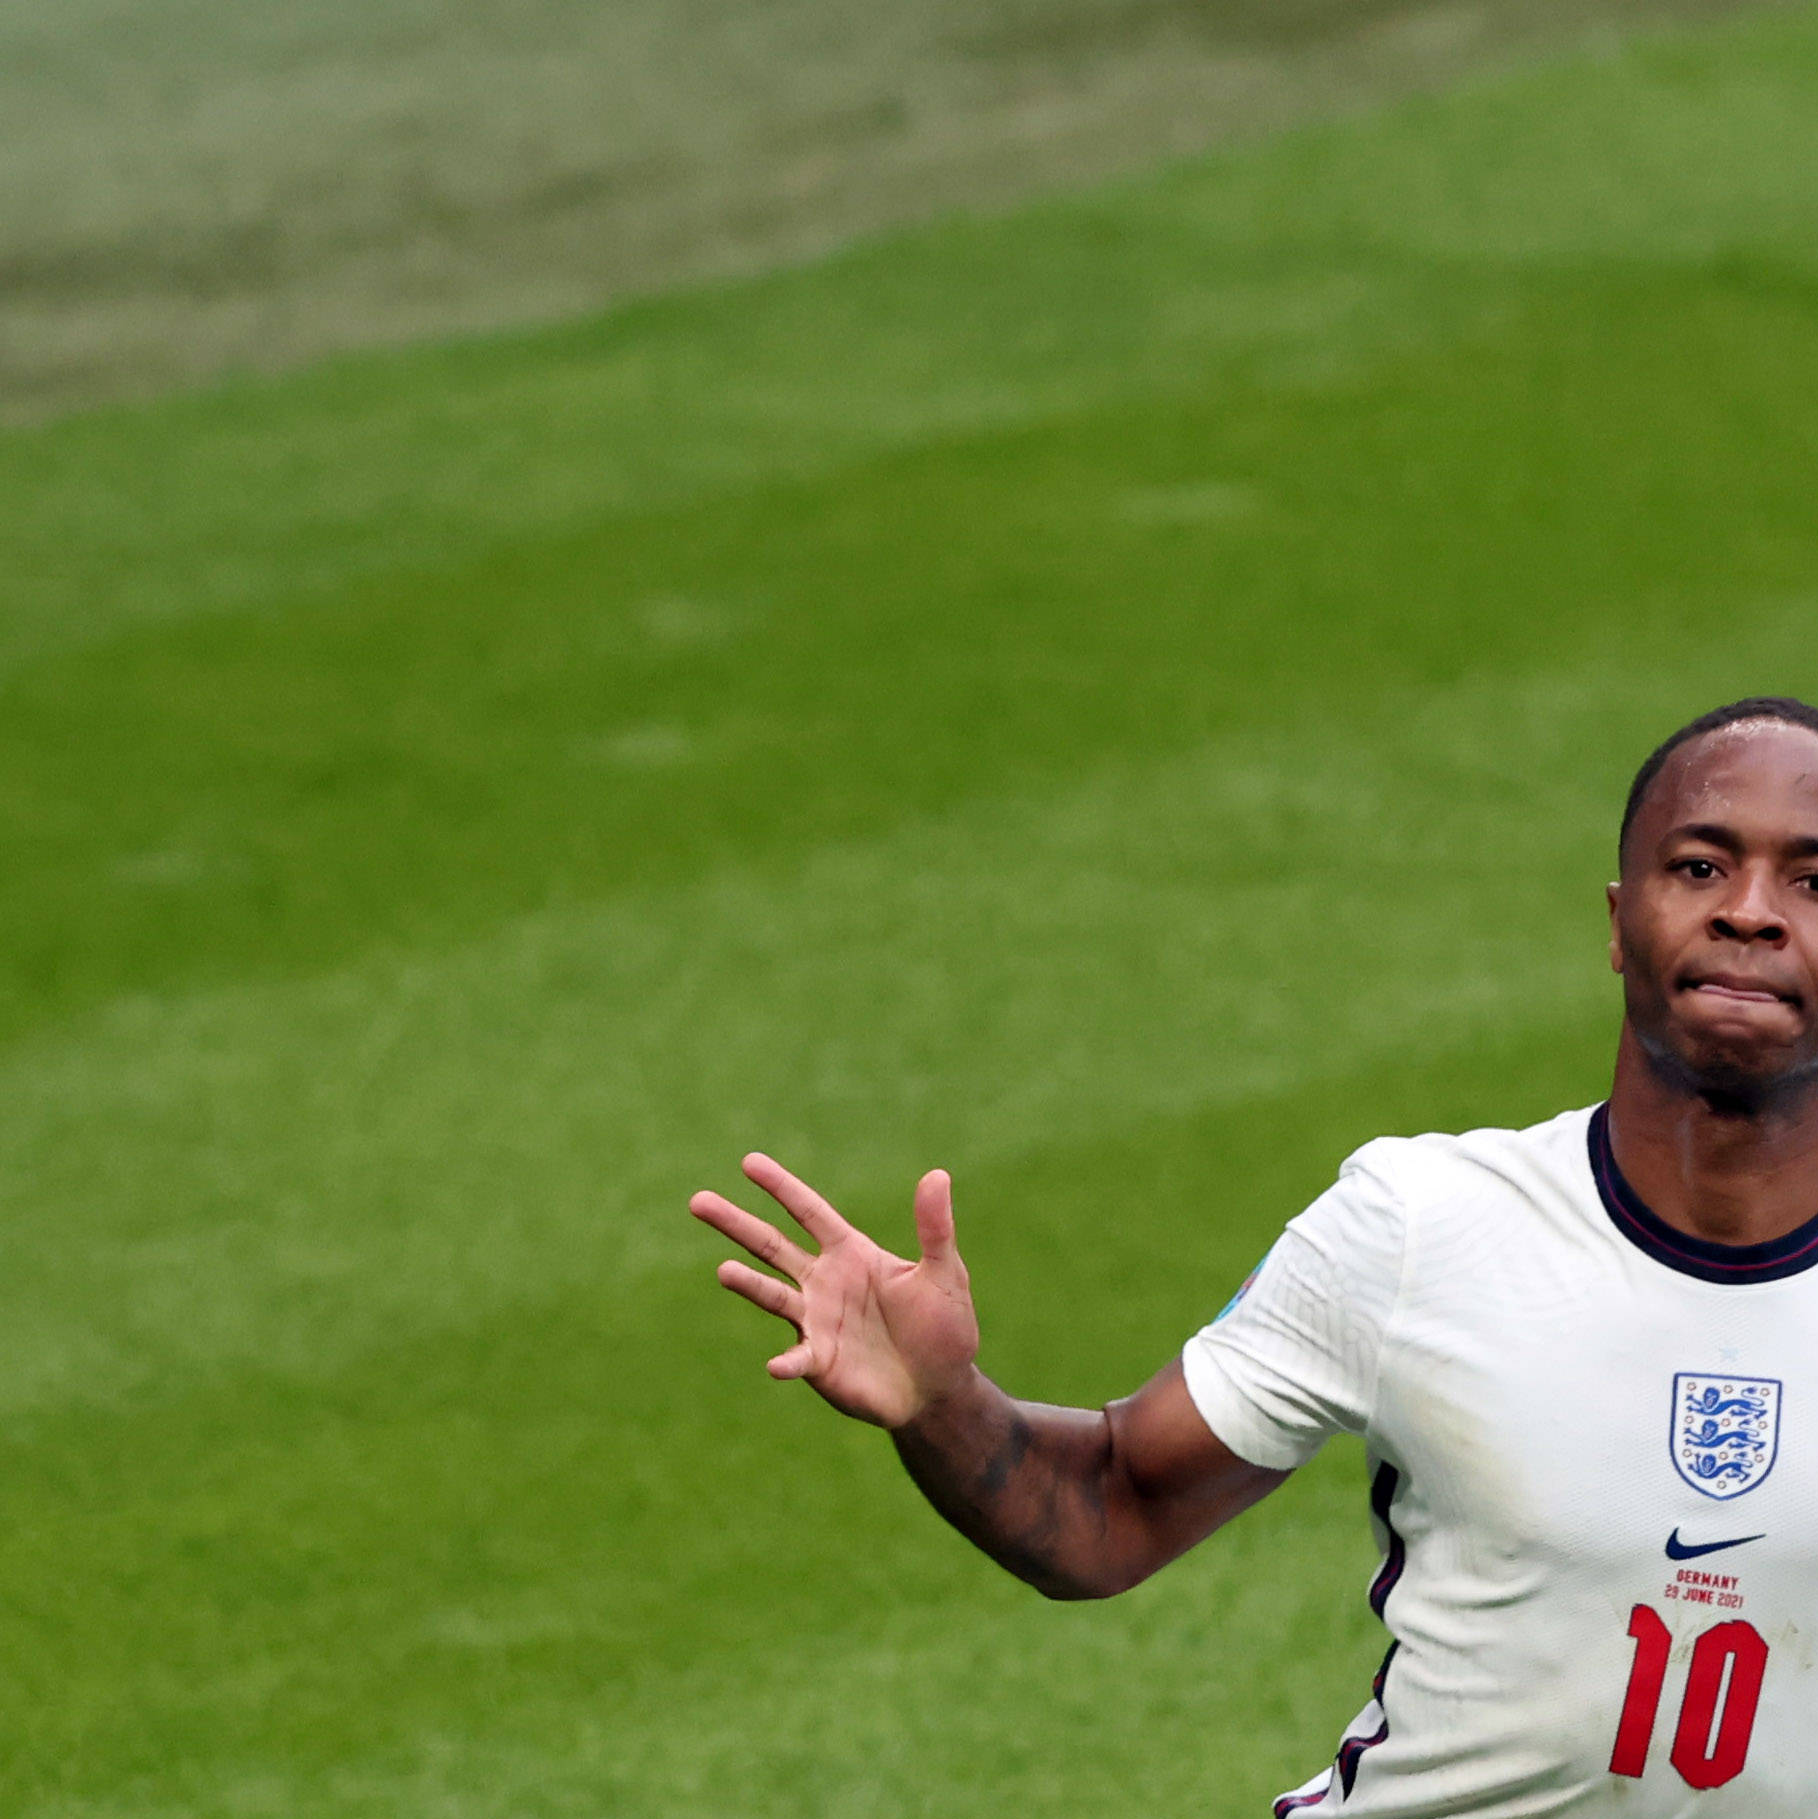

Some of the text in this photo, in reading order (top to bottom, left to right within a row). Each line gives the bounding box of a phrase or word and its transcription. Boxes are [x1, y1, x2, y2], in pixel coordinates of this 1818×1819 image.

[1677, 1569, 1740, 1590] GERMANY
[1682, 1588, 1714, 1604] JUNE
[1717, 1592, 1744, 1609] 2021
[1609, 1603, 1769, 1790] 10
